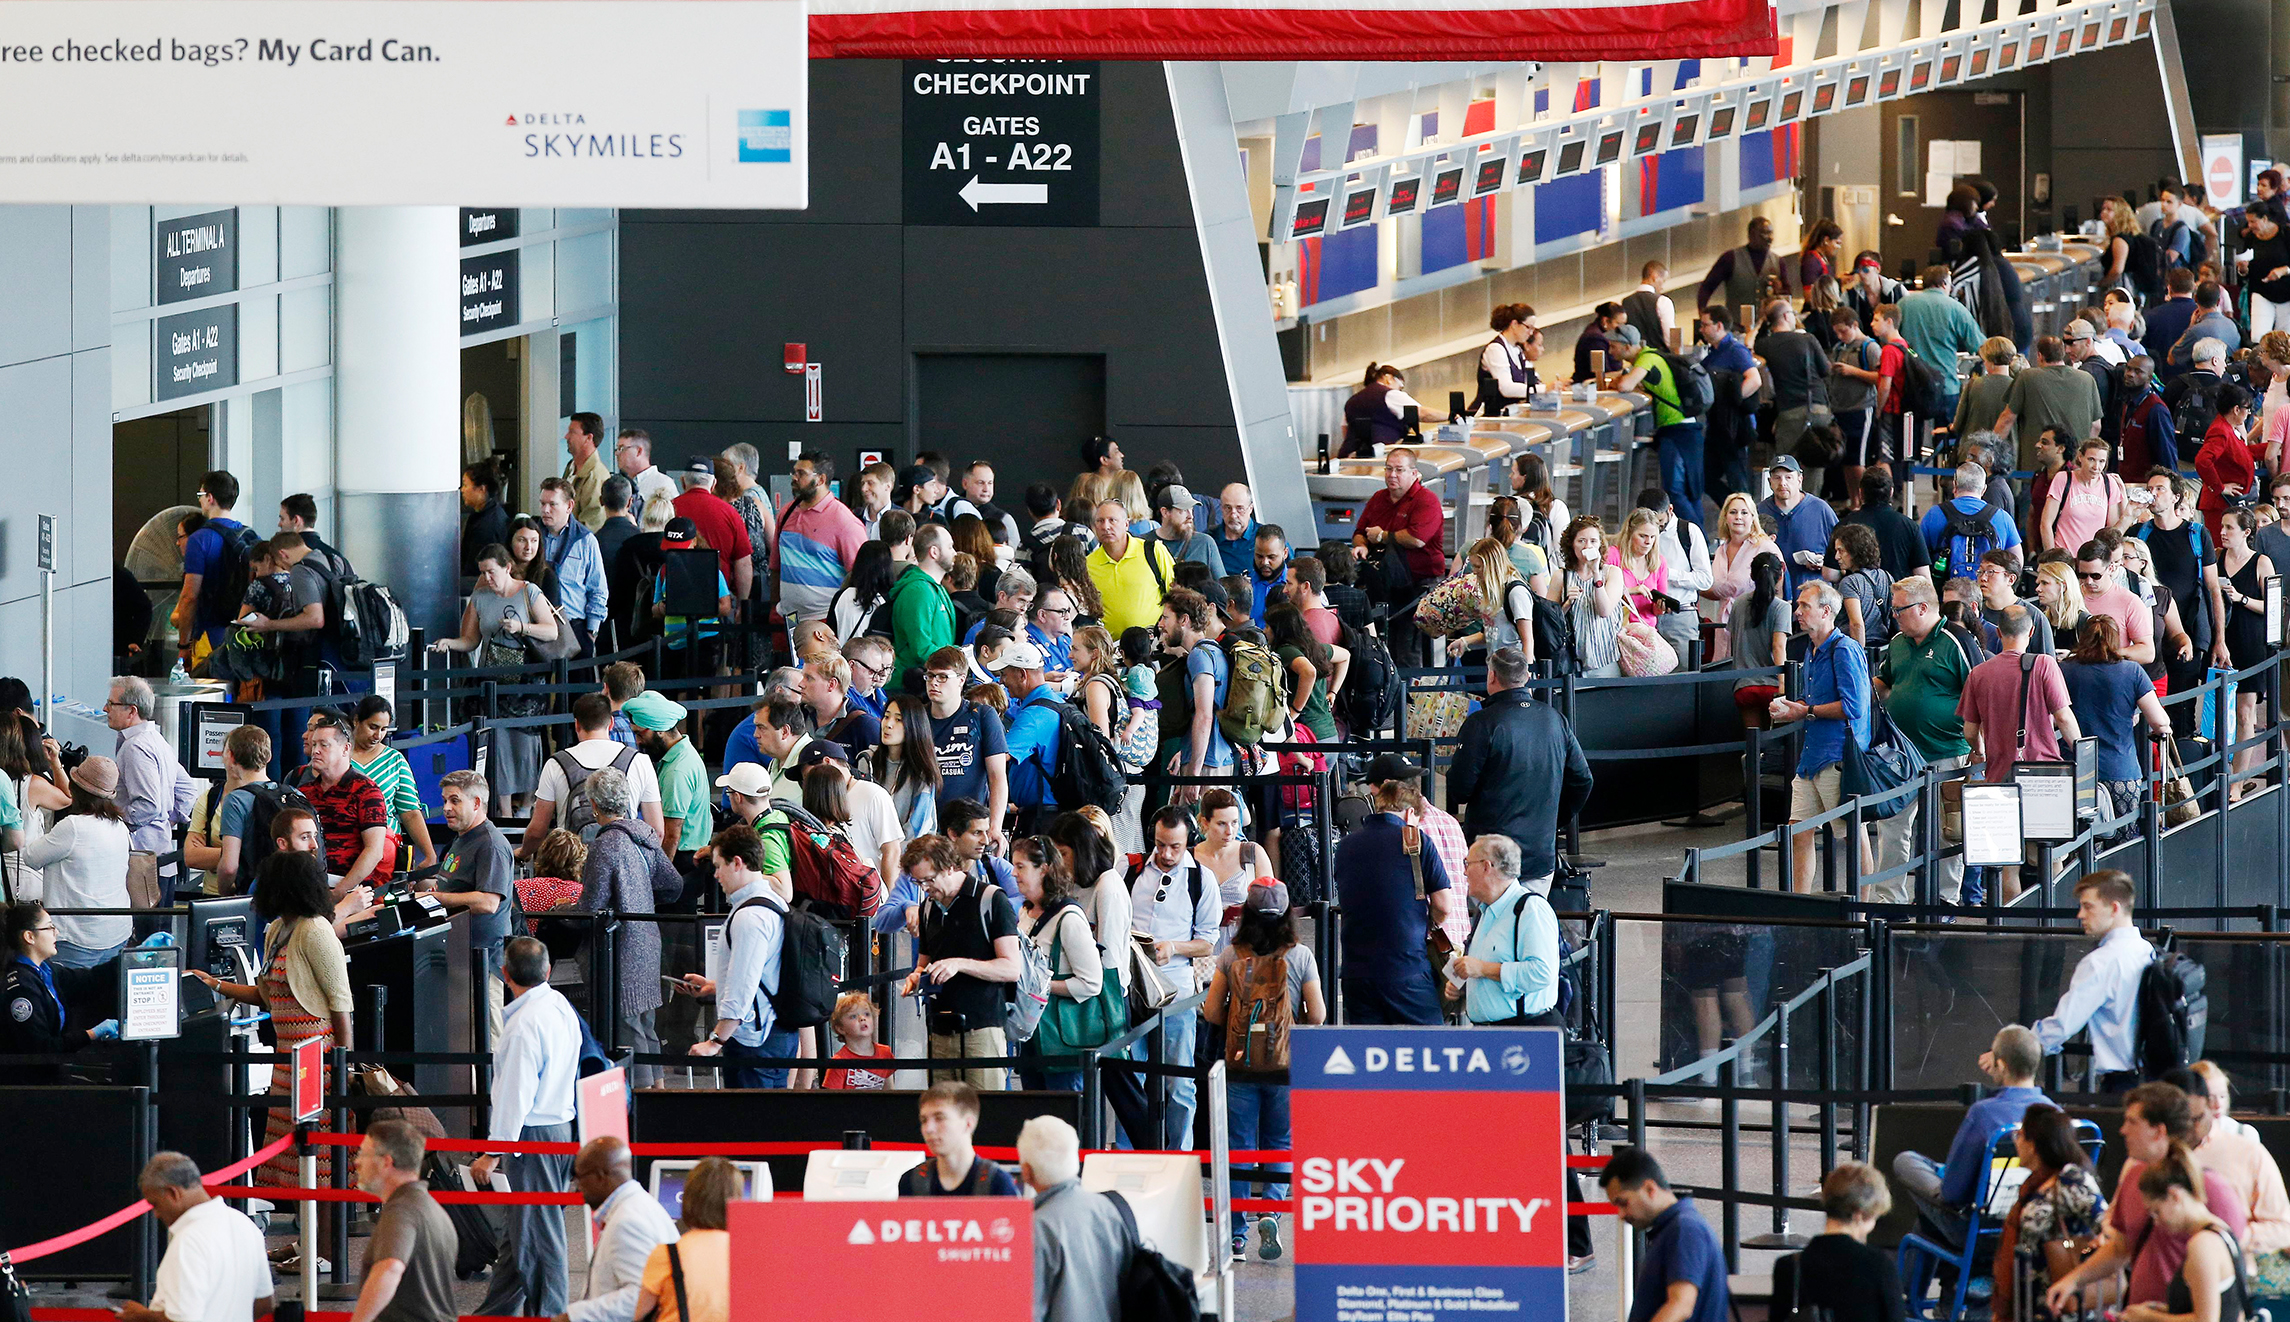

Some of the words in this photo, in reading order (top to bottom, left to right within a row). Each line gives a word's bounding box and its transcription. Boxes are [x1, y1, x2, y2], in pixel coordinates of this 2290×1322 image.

[52, 38, 161, 62] checked
[171, 38, 249, 67] bags?
[258, 39, 301, 66] My
[309, 38, 372, 62] Card
[381, 39, 441, 62] Can.
[913, 73, 1091, 95] CHECKPOINT
[525, 113, 586, 125] DELTA
[963, 116, 1040, 136] GATES
[524, 133, 683, 157] SKYMILES
[929, 142, 970, 170] A1
[1007, 142, 1072, 171] A22
[19, 154, 34, 163] and
[468, 213, 496, 238] Departures
[166, 231, 181, 258] ALL
[181, 225, 218, 255] TERMINAL
[218, 223, 225, 248] A
[180, 266, 211, 291] Departures
[462, 274, 479, 297] Gates
[479, 271, 487, 293] A1
[491, 268, 503, 291] A22
[463, 303, 480, 323] Security
[480, 300, 502, 320] Checkpoint
[172, 332, 191, 356] Gates
[192, 328, 200, 351] A1
[205, 325, 219, 348] A22
[173, 364, 192, 383] Security
[192, 358, 218, 379] Checkpoint
[667, 531, 684, 539] STX
[205, 729, 228, 737] Passen
[135, 974, 165, 983] NOTICE
[1365, 1047, 1491, 1072] DELTA
[1301, 1157, 1405, 1193] SKY
[1302, 1196, 1543, 1233] PRIORITY
[880, 1219, 984, 1243] DELTA
[937, 1247, 1012, 1262] SHUTTLE
[1336, 1285, 1365, 1297] Delta
[1417, 1285, 1426, 1297] &
[1427, 1285, 1474, 1298] Business
[1474, 1285, 1504, 1298] Class
[1386, 1298, 1432, 1310] Platinum
[1433, 1298, 1442, 1310] &
[1443, 1298, 1468, 1311] Gold
[1469, 1299, 1520, 1312] Medallion
